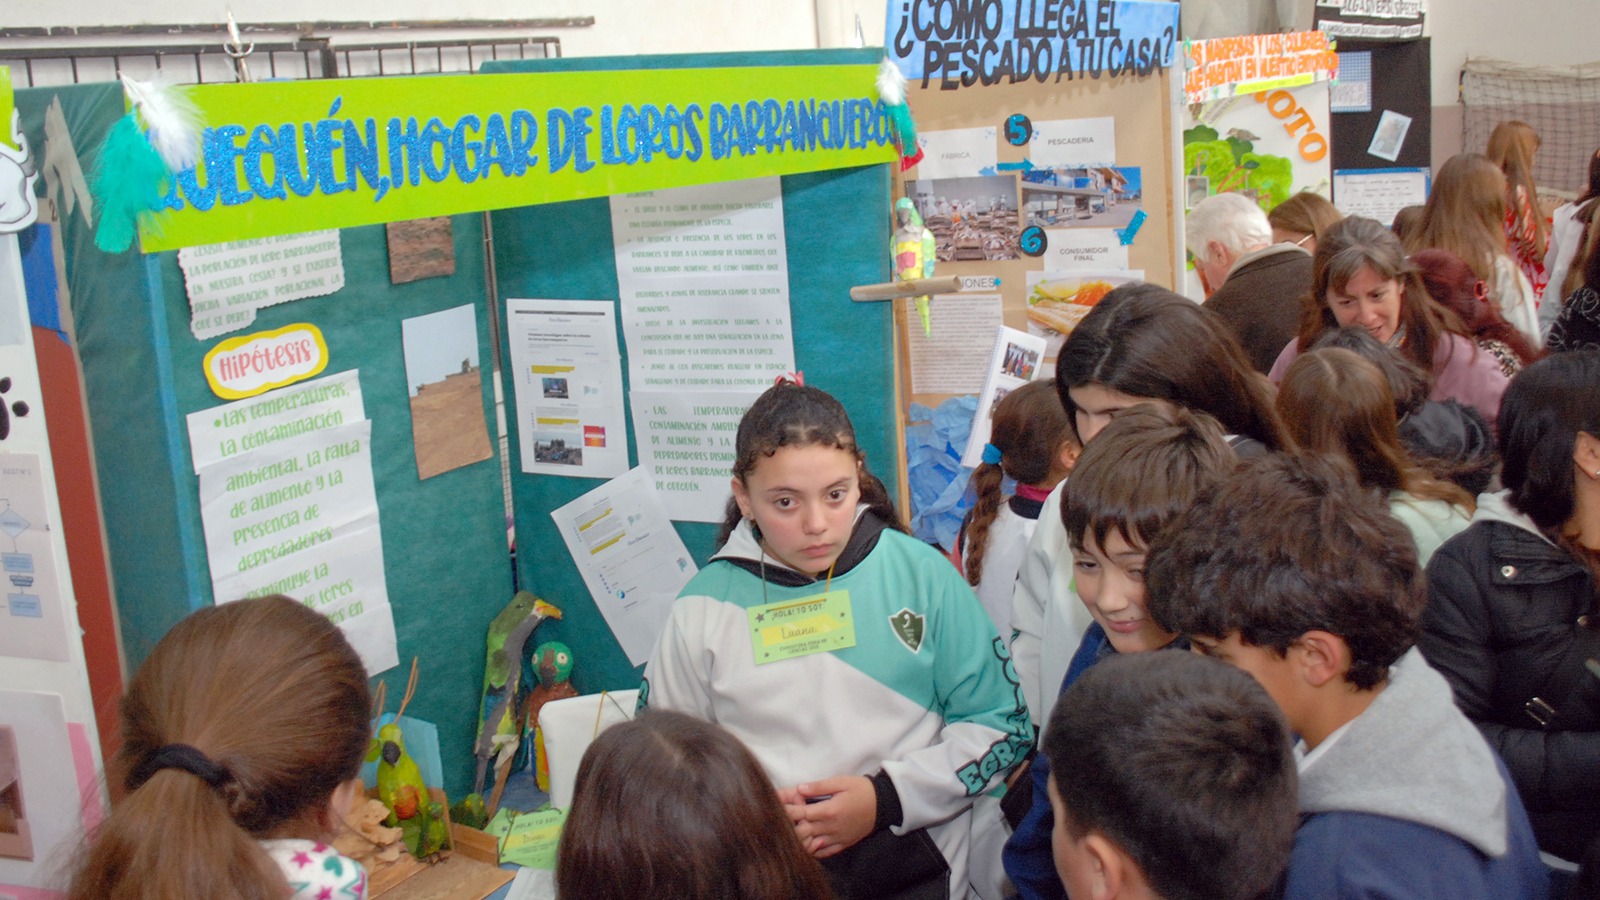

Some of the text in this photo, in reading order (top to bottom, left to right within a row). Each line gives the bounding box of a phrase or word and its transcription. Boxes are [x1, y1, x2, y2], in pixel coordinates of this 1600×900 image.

[1014, 0, 1088, 39] LLEGA
[1096, 0, 1121, 37] EL
[921, 26, 1173, 90] PESCADO A TU CASA?
[1184, 40, 1203, 67] AS
[547, 106, 597, 175] DE
[600, 103, 705, 167] LOROS
[1009, 114, 1028, 146] 5
[1020, 227, 1042, 254] 6
[1060, 247, 1109, 255] CONSUMIDOR
[202, 256, 247, 272] POBLACIÓN
[653, 406, 667, 415] LAS
[649, 421, 741, 432] CONTAMINACIÓN AMBIEN
[651, 436, 731, 446] DE ALIMENTO Y LA
[654, 450, 737, 462] DEPREDADORES DISMIN
[655, 465, 733, 477] DE LOROS BARRANQU
[230, 501, 247, 519] de
[251, 480, 313, 512] alimento
[316, 475, 325, 491] y
[655, 481, 664, 490] DE
[233, 504, 320, 546] presencia de
[238, 526, 334, 572] depredadores
[319, 578, 353, 605] loros
[348, 600, 364, 618] en
